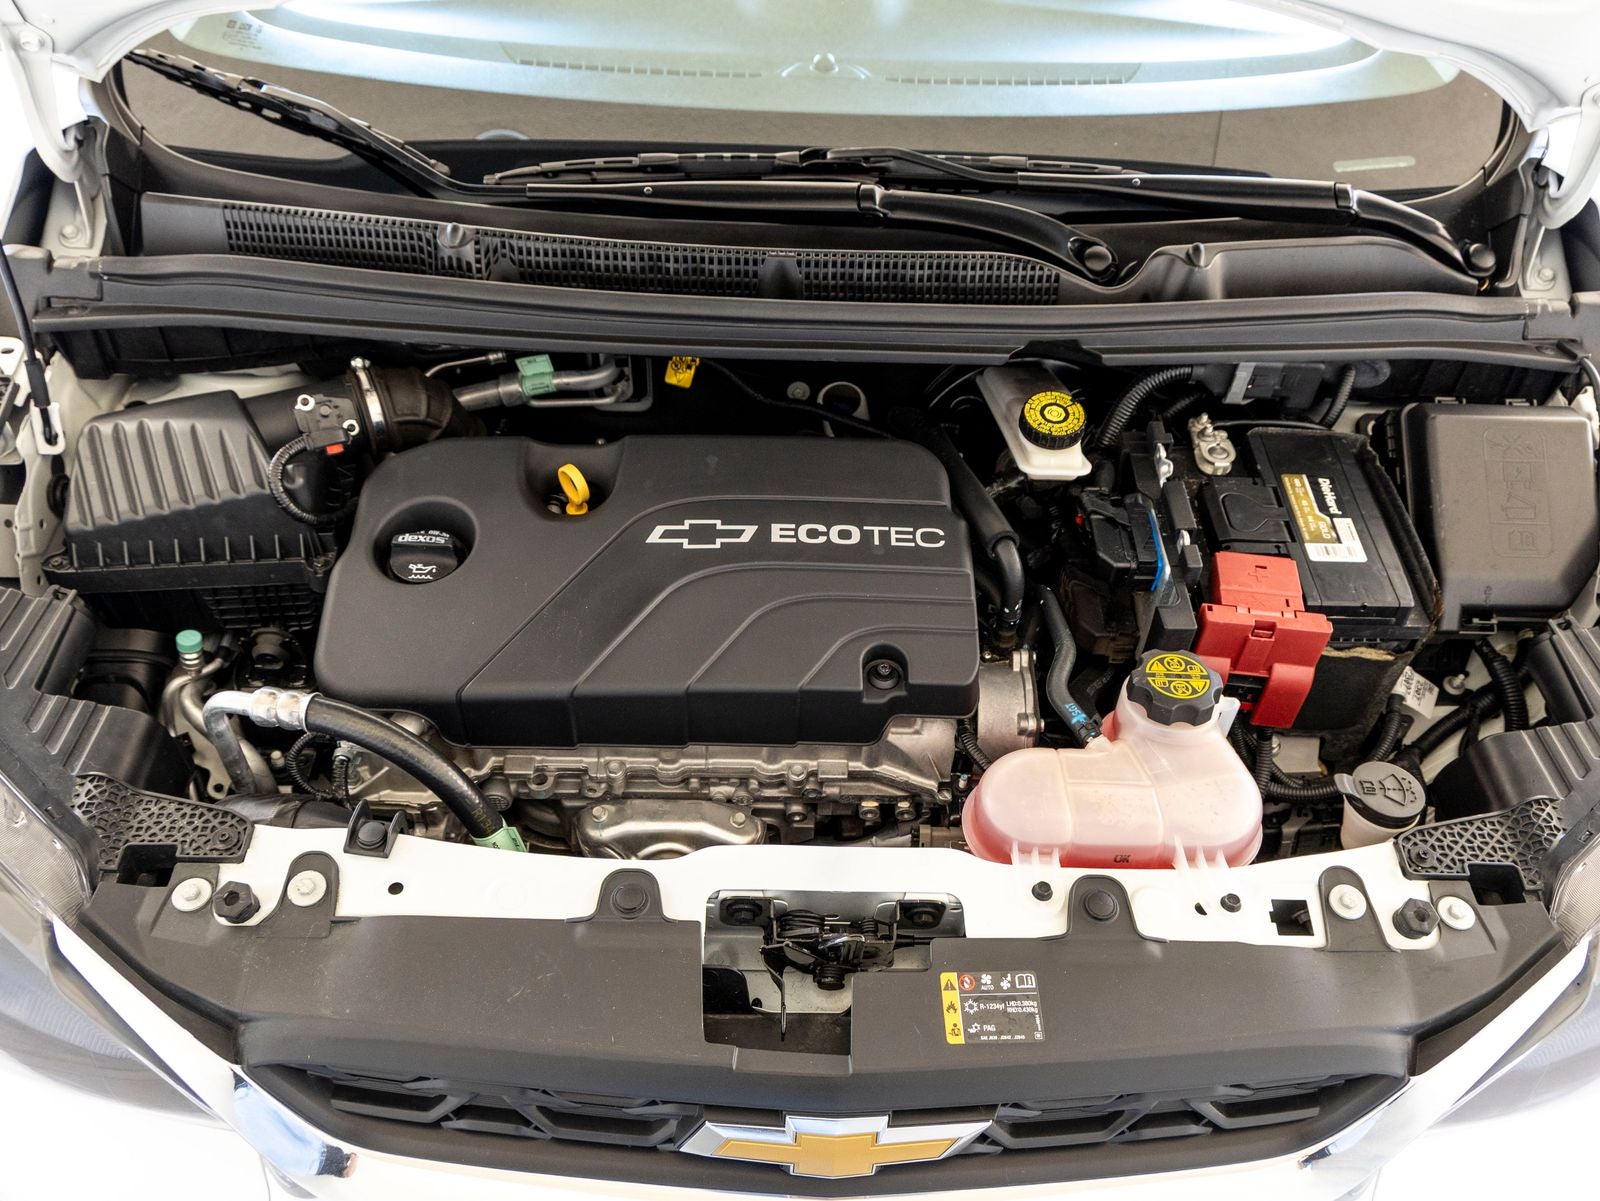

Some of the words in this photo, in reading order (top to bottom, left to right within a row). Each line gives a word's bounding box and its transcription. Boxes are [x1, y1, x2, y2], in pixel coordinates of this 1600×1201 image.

[1317, 477, 1343, 515] DieHard
[398, 533, 446, 544] dexos
[770, 523, 946, 548] ECOTEC
